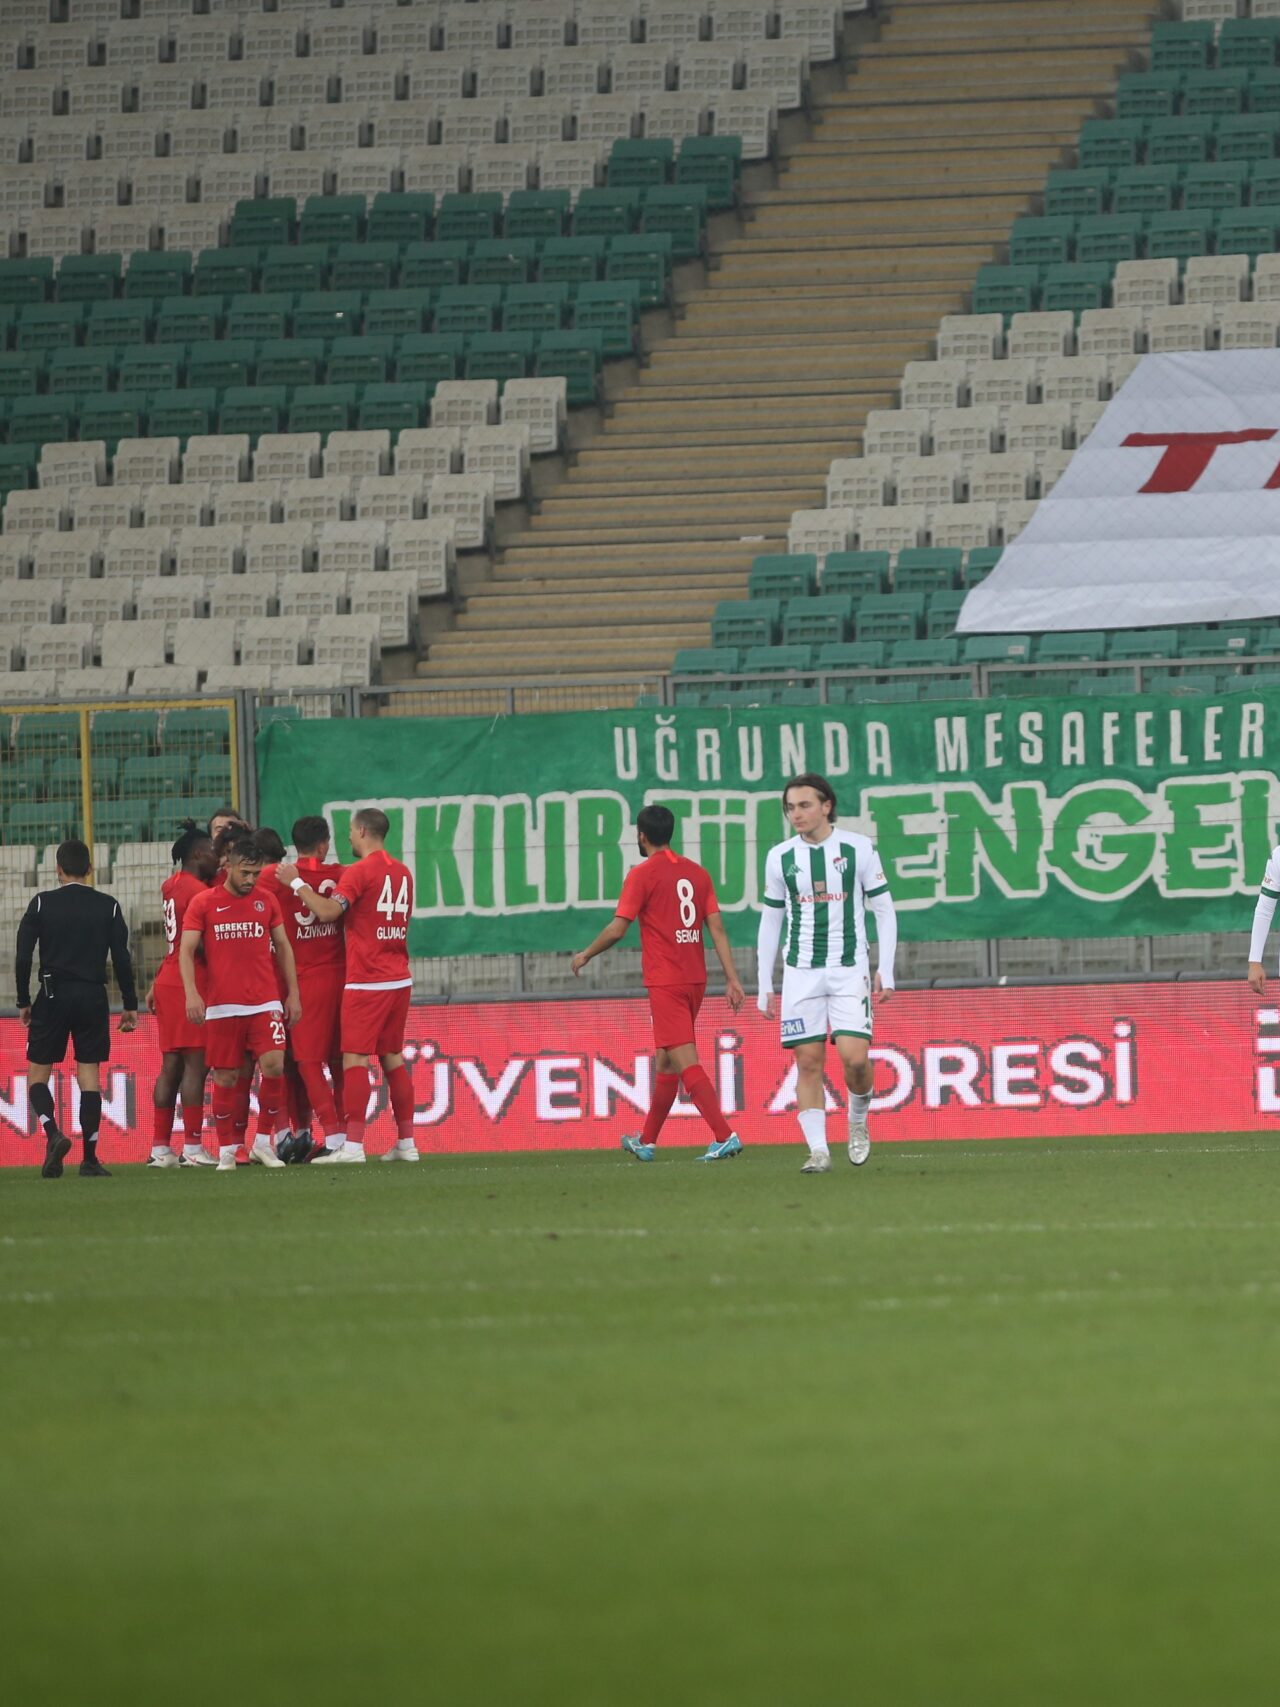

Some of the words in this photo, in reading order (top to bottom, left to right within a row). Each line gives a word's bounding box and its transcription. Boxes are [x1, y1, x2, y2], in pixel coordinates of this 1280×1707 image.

[613, 713, 893, 782] UĞRUNDA
[934, 702, 1266, 773] MESAFELER
[376, 874, 409, 922] 44
[676, 878, 697, 928] 8
[213, 922, 254, 933] BEREKET
[215, 931, 254, 941] SIGORTA
[269, 1021, 286, 1040] 23
